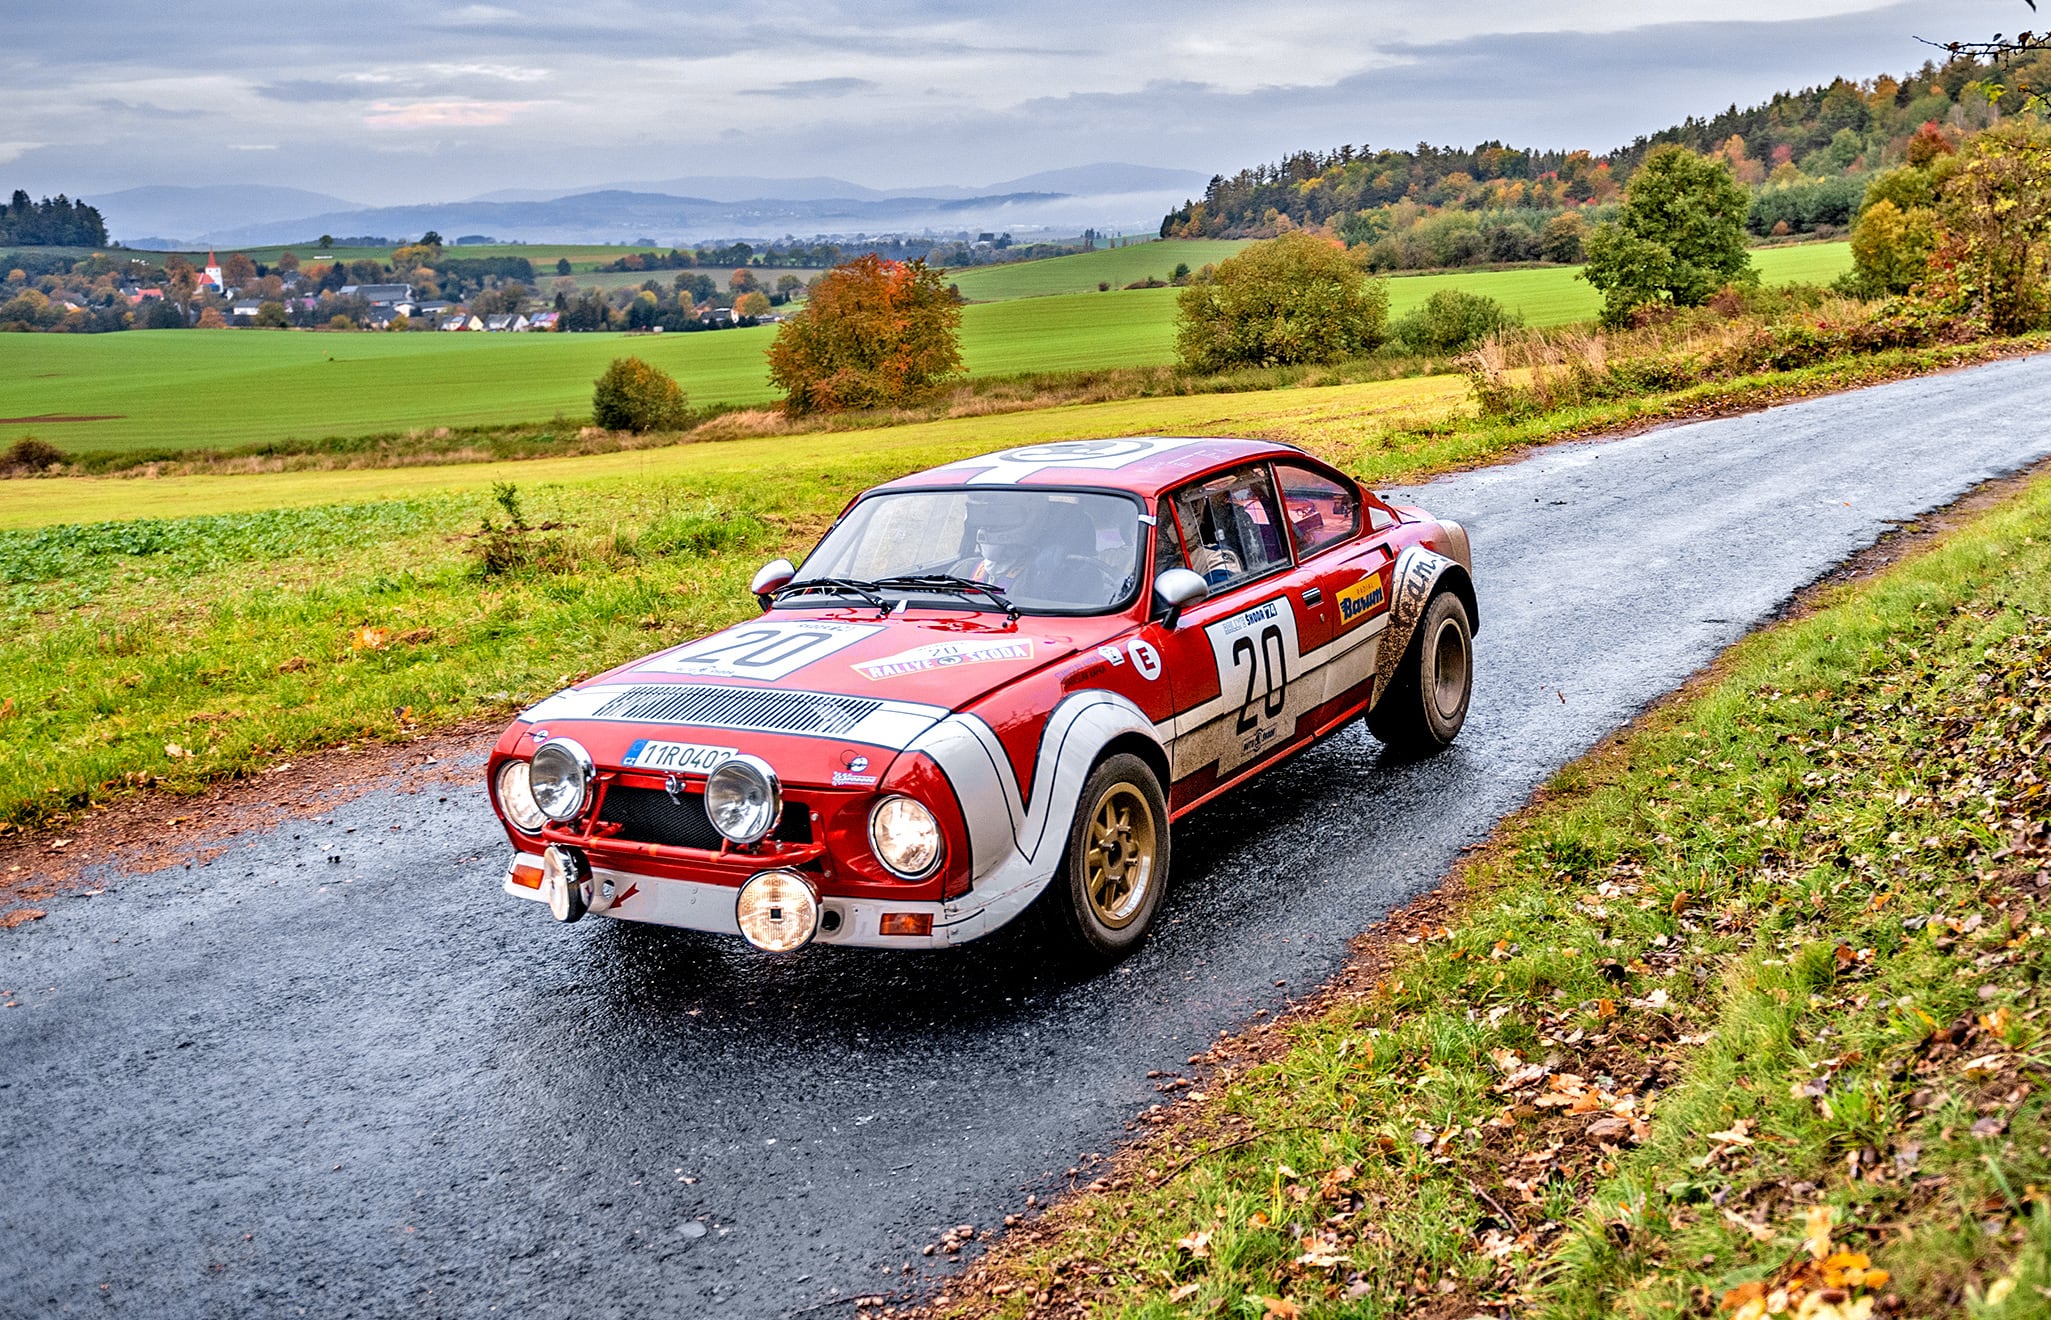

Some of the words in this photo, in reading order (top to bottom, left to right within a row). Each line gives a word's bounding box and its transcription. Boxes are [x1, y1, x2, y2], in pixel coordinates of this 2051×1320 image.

[1340, 586, 1384, 620] Barum
[678, 630, 833, 667] 20
[928, 646, 958, 657] 20
[1136, 647, 1156, 671] E
[868, 659, 934, 679] RALLYE
[1232, 624, 1288, 736] 20
[623, 757, 636, 766] CZ
